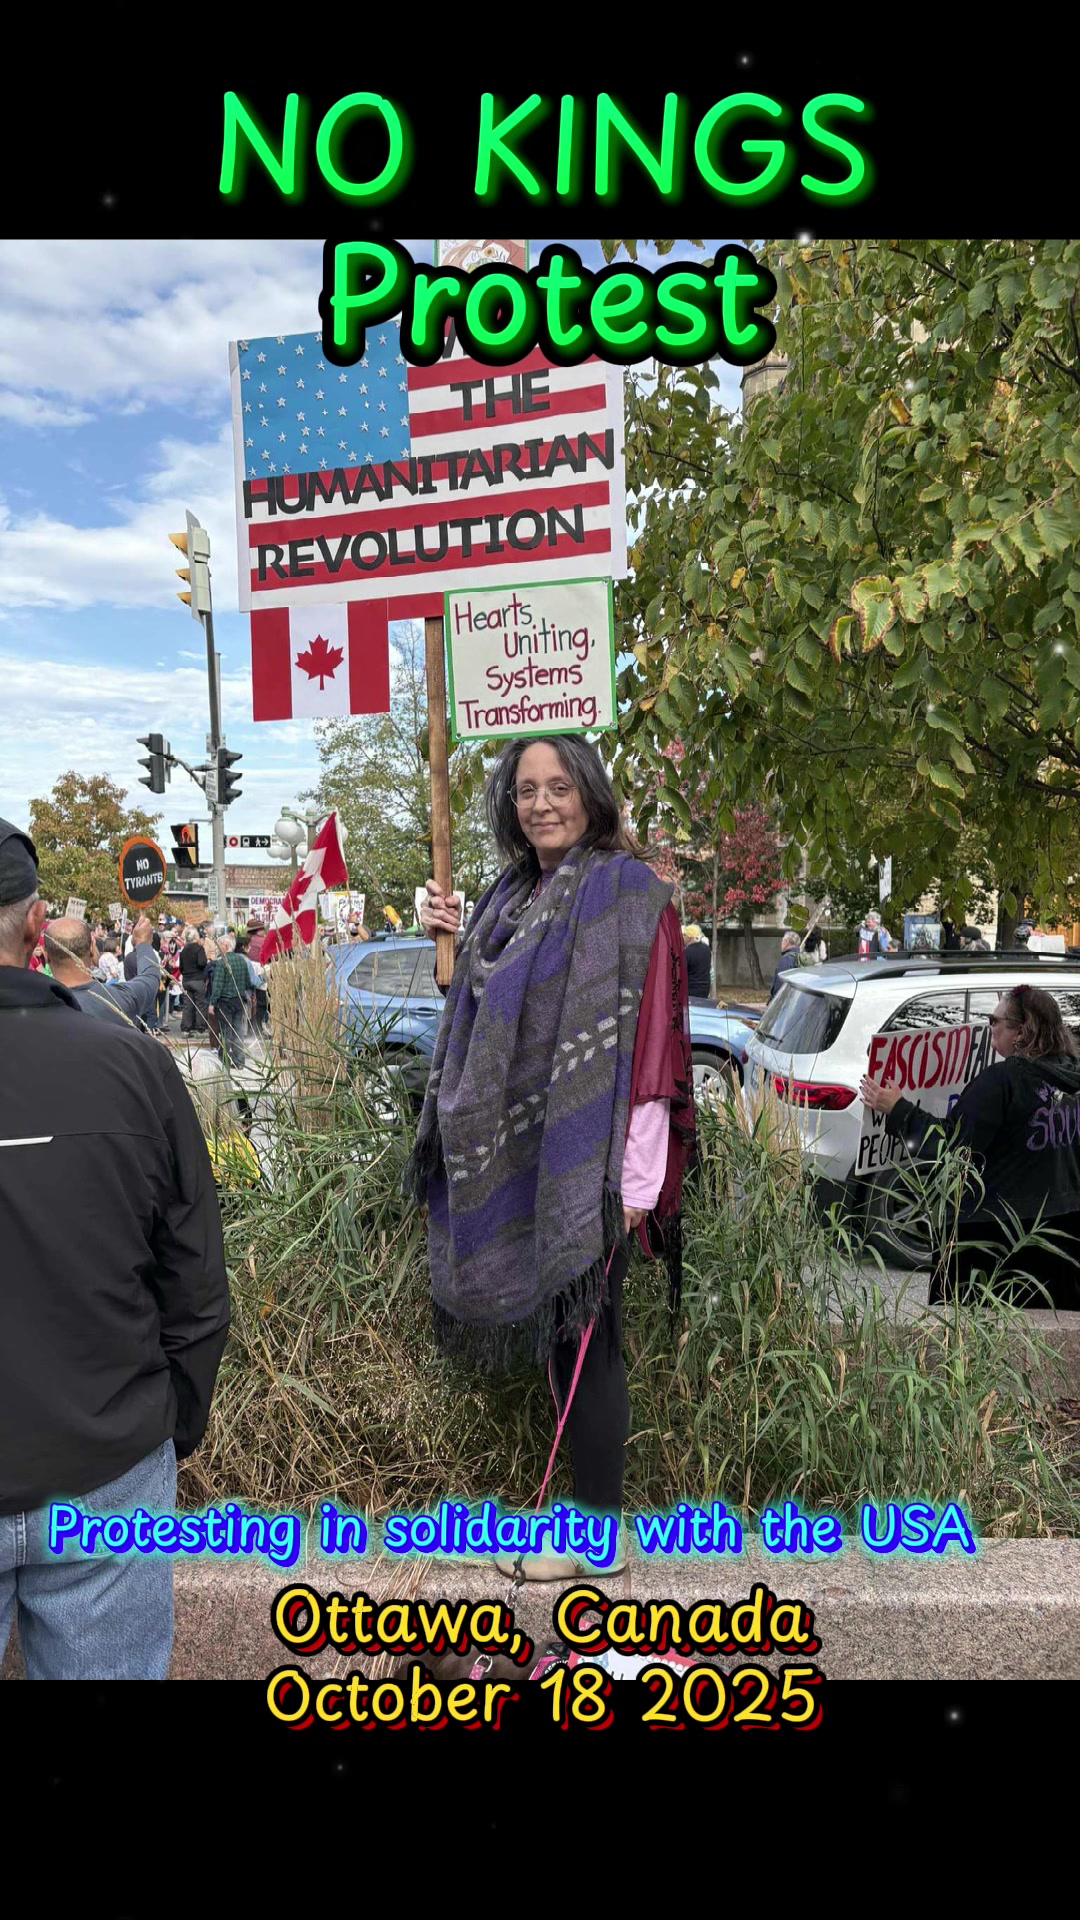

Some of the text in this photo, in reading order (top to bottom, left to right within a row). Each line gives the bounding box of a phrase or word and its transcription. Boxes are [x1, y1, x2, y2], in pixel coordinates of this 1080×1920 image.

[450, 368, 550, 421] THE
[243, 429, 614, 518] HUMANITARIAN
[257, 504, 584, 581] REVOLUTION
[454, 592, 533, 635] Hearts
[124, 872, 163, 890] TYRANTS
[136, 858, 150, 871] NO
